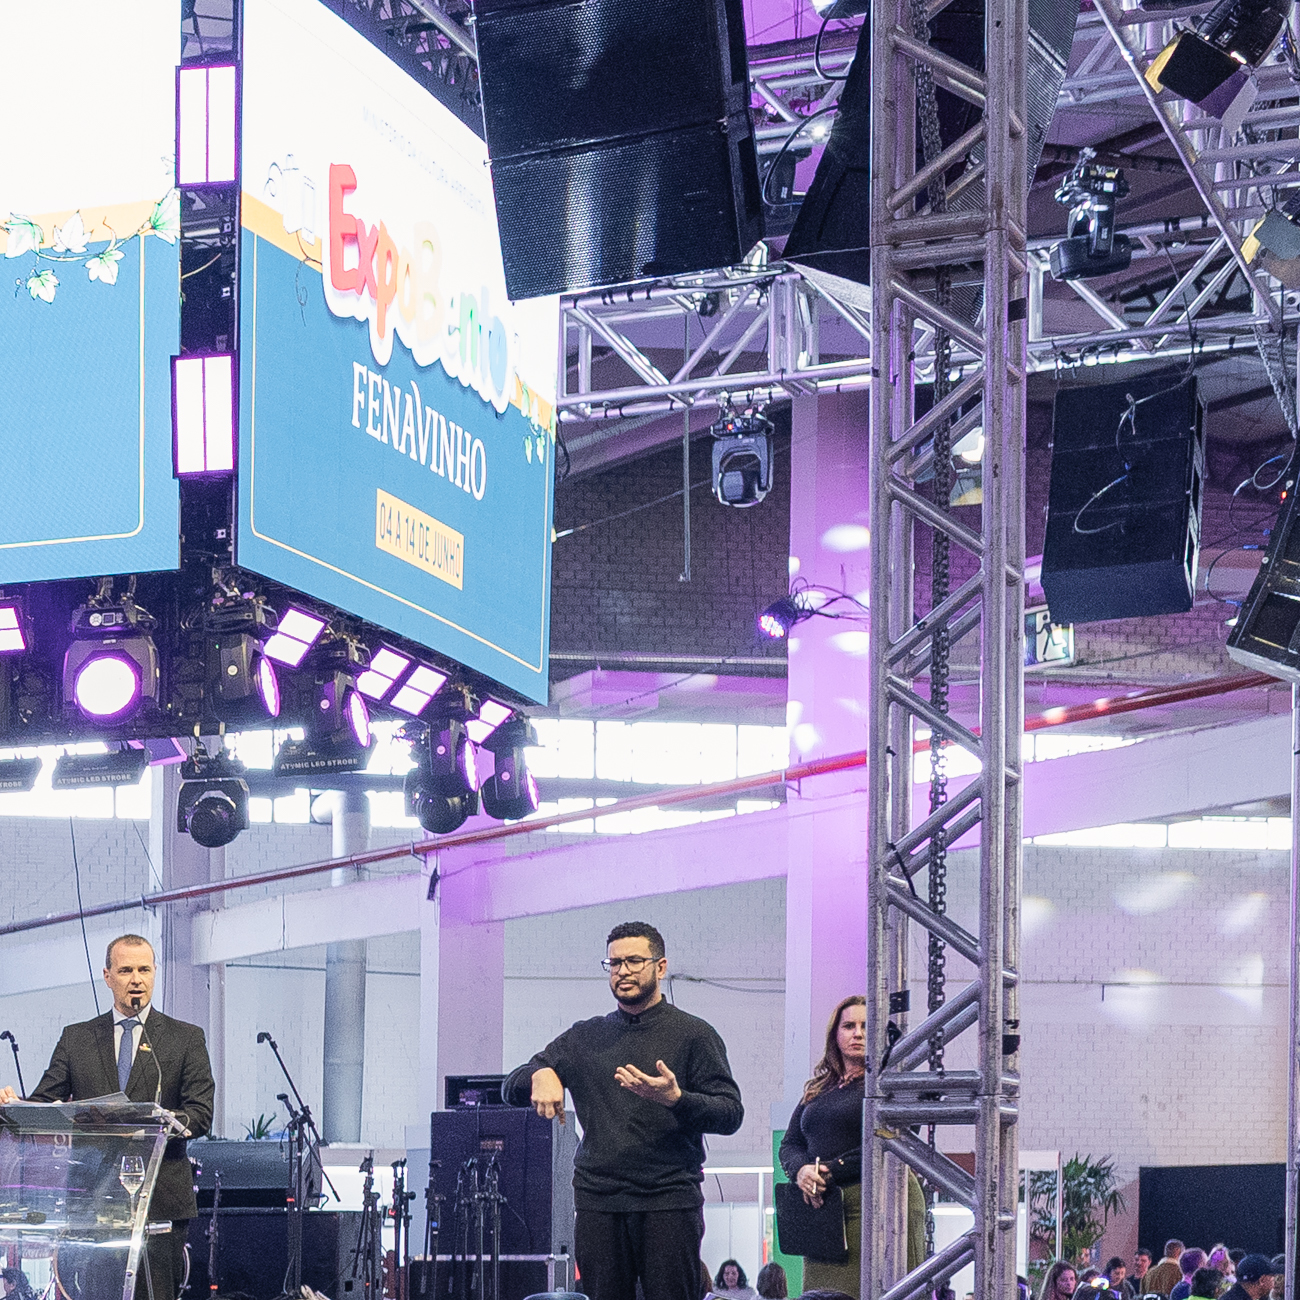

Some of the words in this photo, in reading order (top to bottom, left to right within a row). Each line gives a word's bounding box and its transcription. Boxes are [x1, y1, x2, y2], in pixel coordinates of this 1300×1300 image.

[351, 360, 487, 501] FENAVINHO
[379, 501, 392, 544] 04
[394, 510, 401, 549] A
[405, 515, 415, 556] 14
[418, 521, 430, 563] DE
[432, 530, 461, 579] JUNHO
